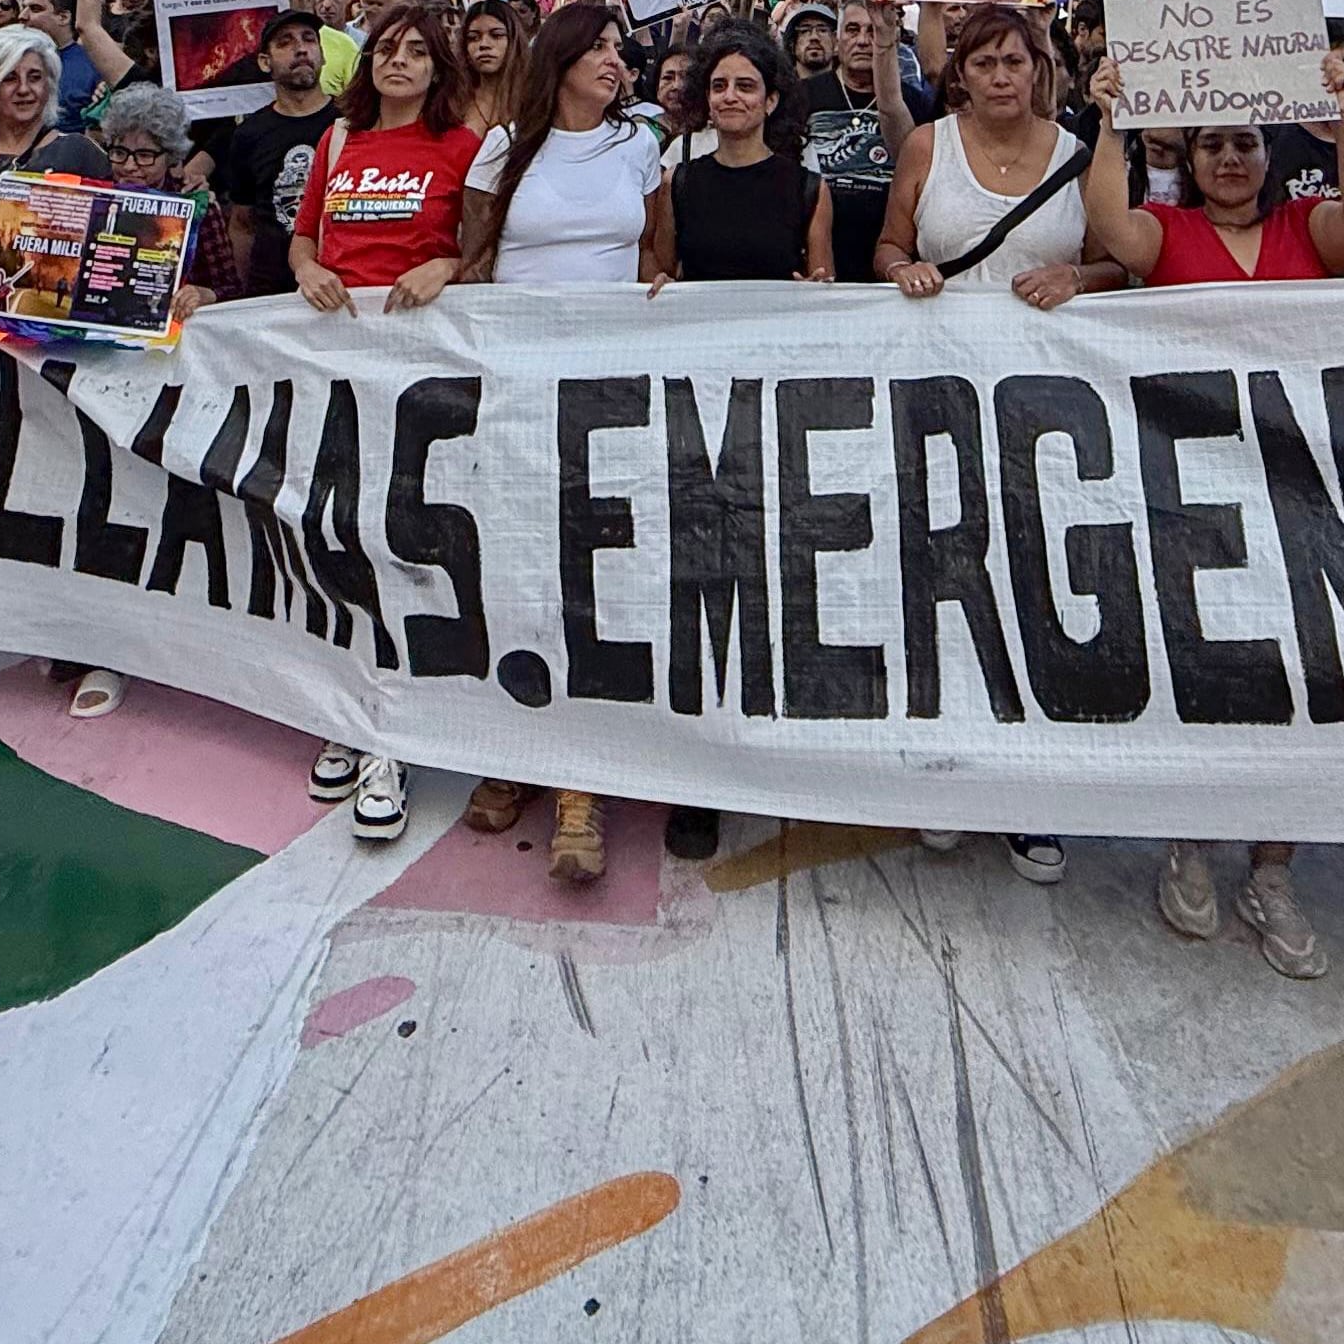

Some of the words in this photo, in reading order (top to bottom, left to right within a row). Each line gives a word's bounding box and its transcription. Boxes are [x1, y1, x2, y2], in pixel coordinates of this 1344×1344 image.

[1159, 1, 1214, 30] NO
[1109, 34, 1232, 65] DESASTRE
[1242, 31, 1329, 58] NATURAL
[1180, 68, 1211, 90] ES
[1114, 88, 1284, 119] ABANDONO
[121, 197, 158, 216] FUERA
[160, 201, 192, 219] MILEI
[348, 200, 362, 210] LA
[363, 200, 420, 212] IZQUIERDA
[12, 234, 49, 254] FUERA
[50, 239, 83, 258] MILEI
